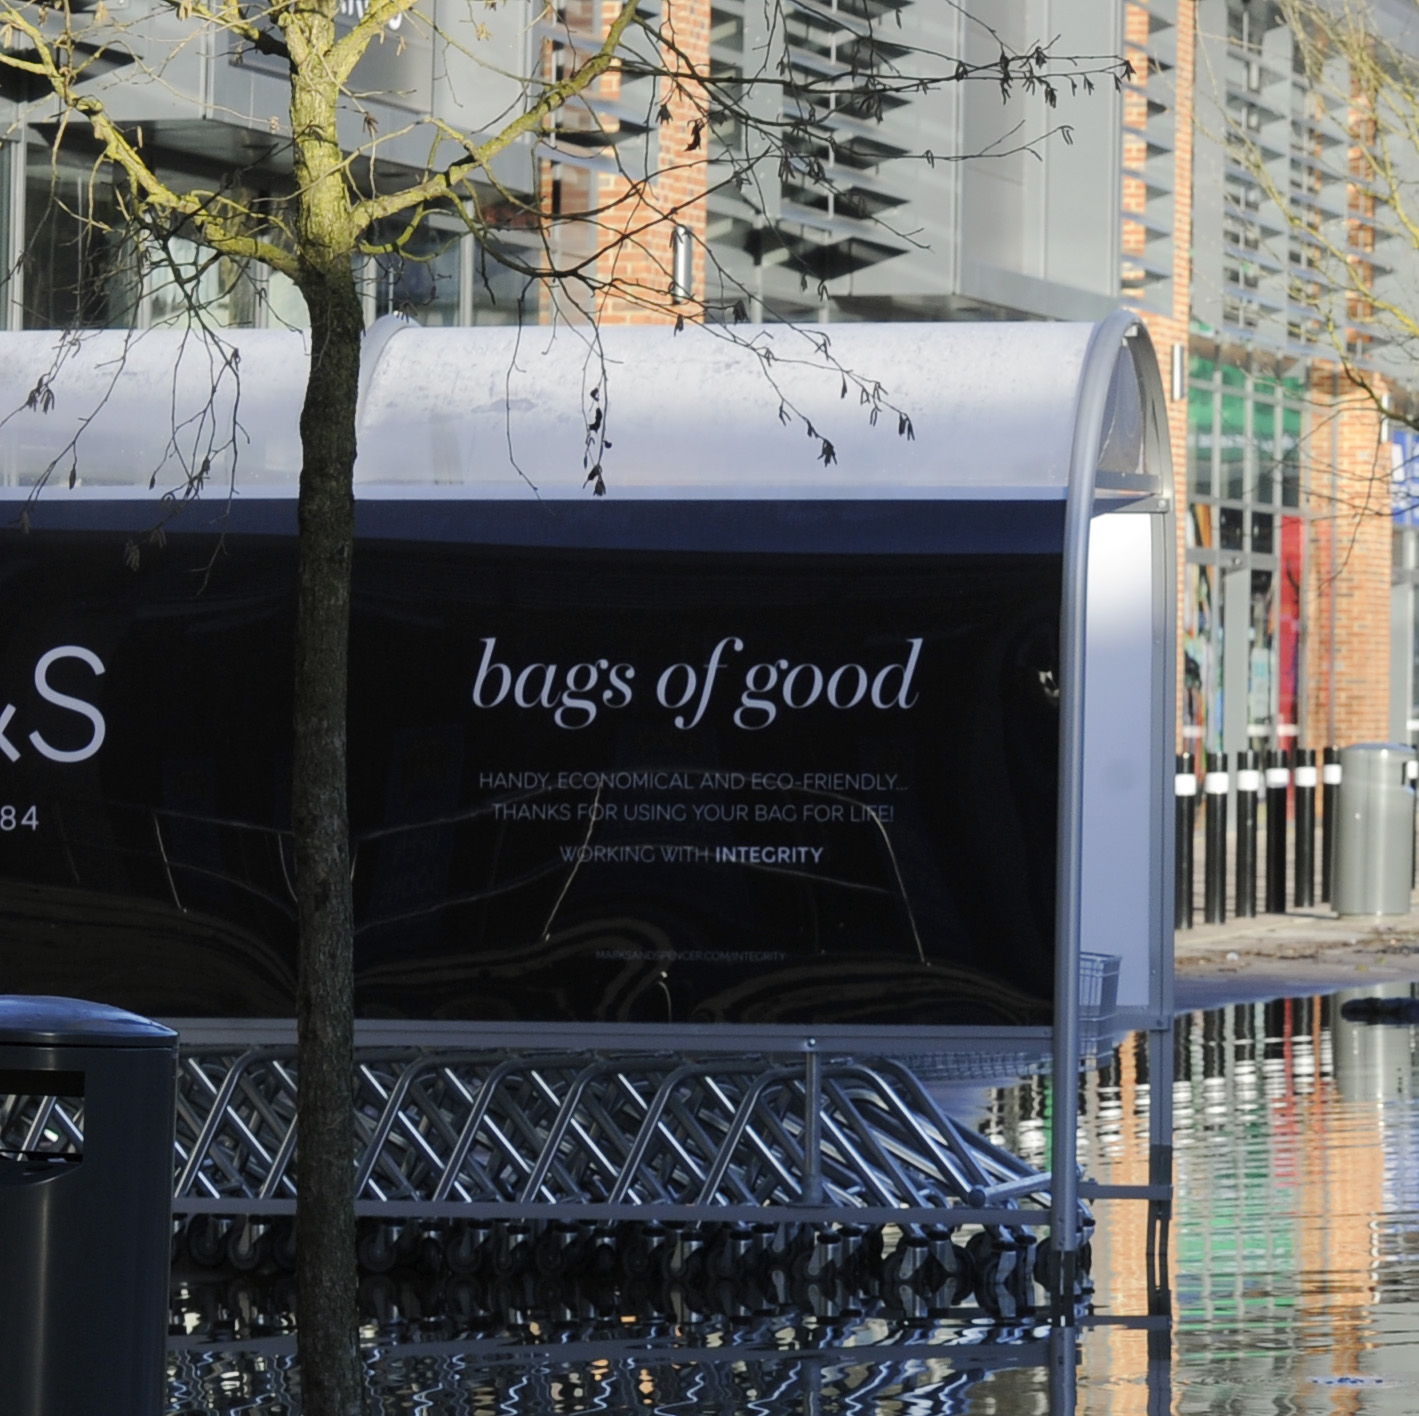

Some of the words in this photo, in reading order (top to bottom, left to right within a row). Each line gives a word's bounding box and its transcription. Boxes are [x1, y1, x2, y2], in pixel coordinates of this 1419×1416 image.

[472, 637, 636, 730] bags
[656, 636, 744, 730] of
[733, 638, 922, 730] good
[479, 772, 553, 791] HANDY,
[557, 773, 695, 790] ECONOMICAL
[700, 773, 745, 791] AND
[491, 804, 571, 821] THANKS
[578, 804, 618, 821] FOR
[624, 804, 687, 821] USING
[692, 804, 749, 821] YOUR
[755, 804, 797, 822] BAG
[803, 804, 844, 822] FOR
[850, 805, 894, 822] LIFE!
[560, 845, 656, 863] WORKING
[660, 845, 709, 862] WITH
[715, 846, 824, 864] INTEGRITY
